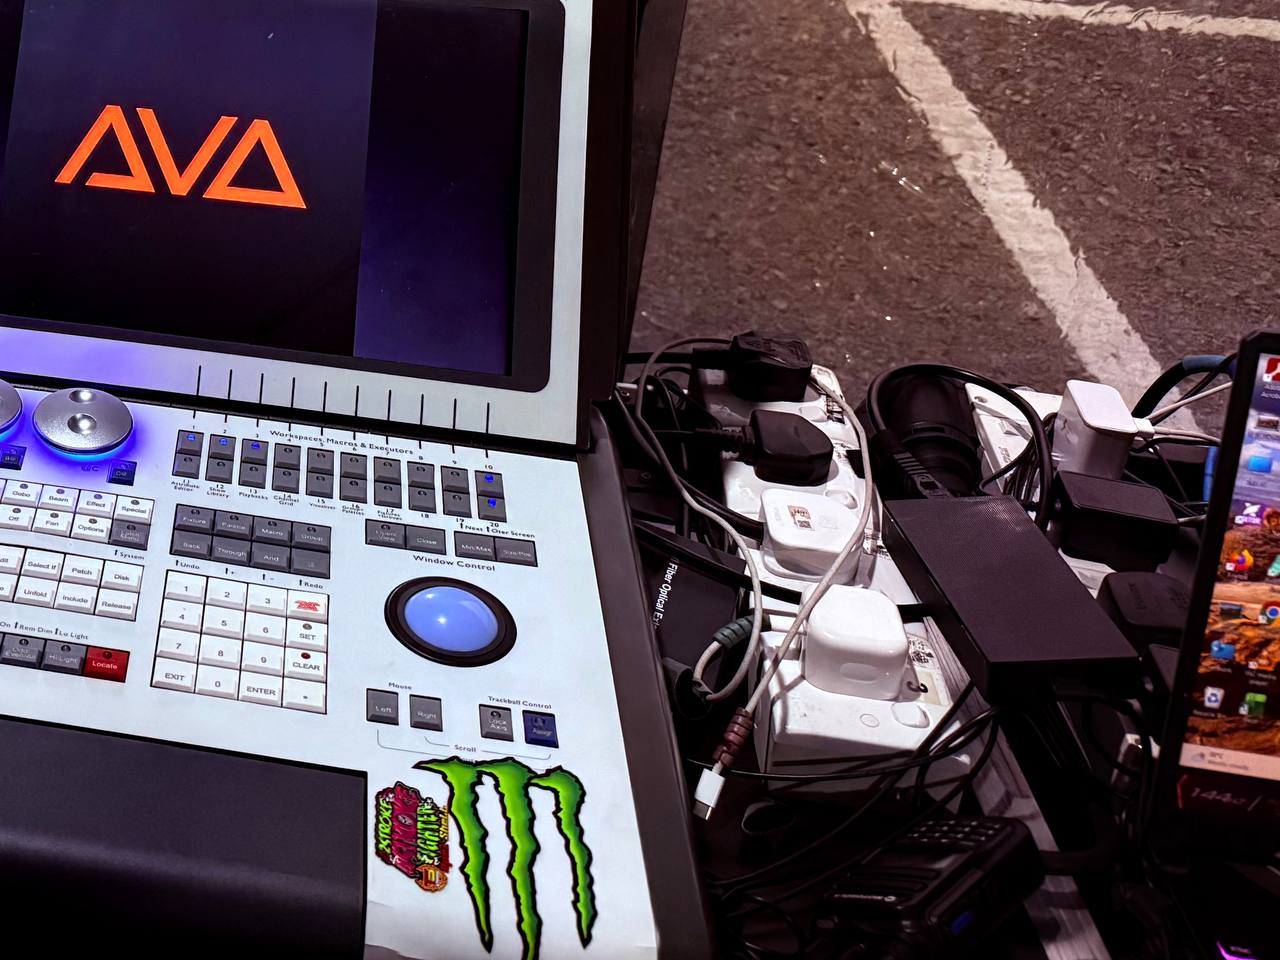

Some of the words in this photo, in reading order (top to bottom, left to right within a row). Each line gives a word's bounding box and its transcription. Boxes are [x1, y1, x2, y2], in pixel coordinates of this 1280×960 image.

[327, 438, 358, 447] Macros
[370, 444, 413, 454] Executors
[49, 495, 69, 503] Beam
[86, 500, 105, 508] Effect
[122, 506, 146, 514] Special
[78, 524, 104, 533] Options
[120, 552, 144, 560] System
[219, 548, 246, 556] Through
[28, 561, 47, 569] Select
[413, 555, 454, 565] Window
[457, 561, 495, 571] Control
[114, 573, 129, 581] Disk
[664, 563, 678, 583] Fiber
[24, 588, 47, 597] Unfold
[62, 595, 88, 603] Include
[656, 583, 671, 611] Optical
[102, 601, 131, 609] Release
[299, 633, 316, 641] SET
[92, 661, 117, 669] Locate
[293, 662, 320, 670] CLEAR
[389, 682, 412, 690] Mouse
[247, 686, 276, 695] ENTER
[488, 696, 520, 705] Trackball
[522, 701, 552, 709] Control
[417, 710, 437, 720] Right
[454, 745, 476, 753] Scroll
